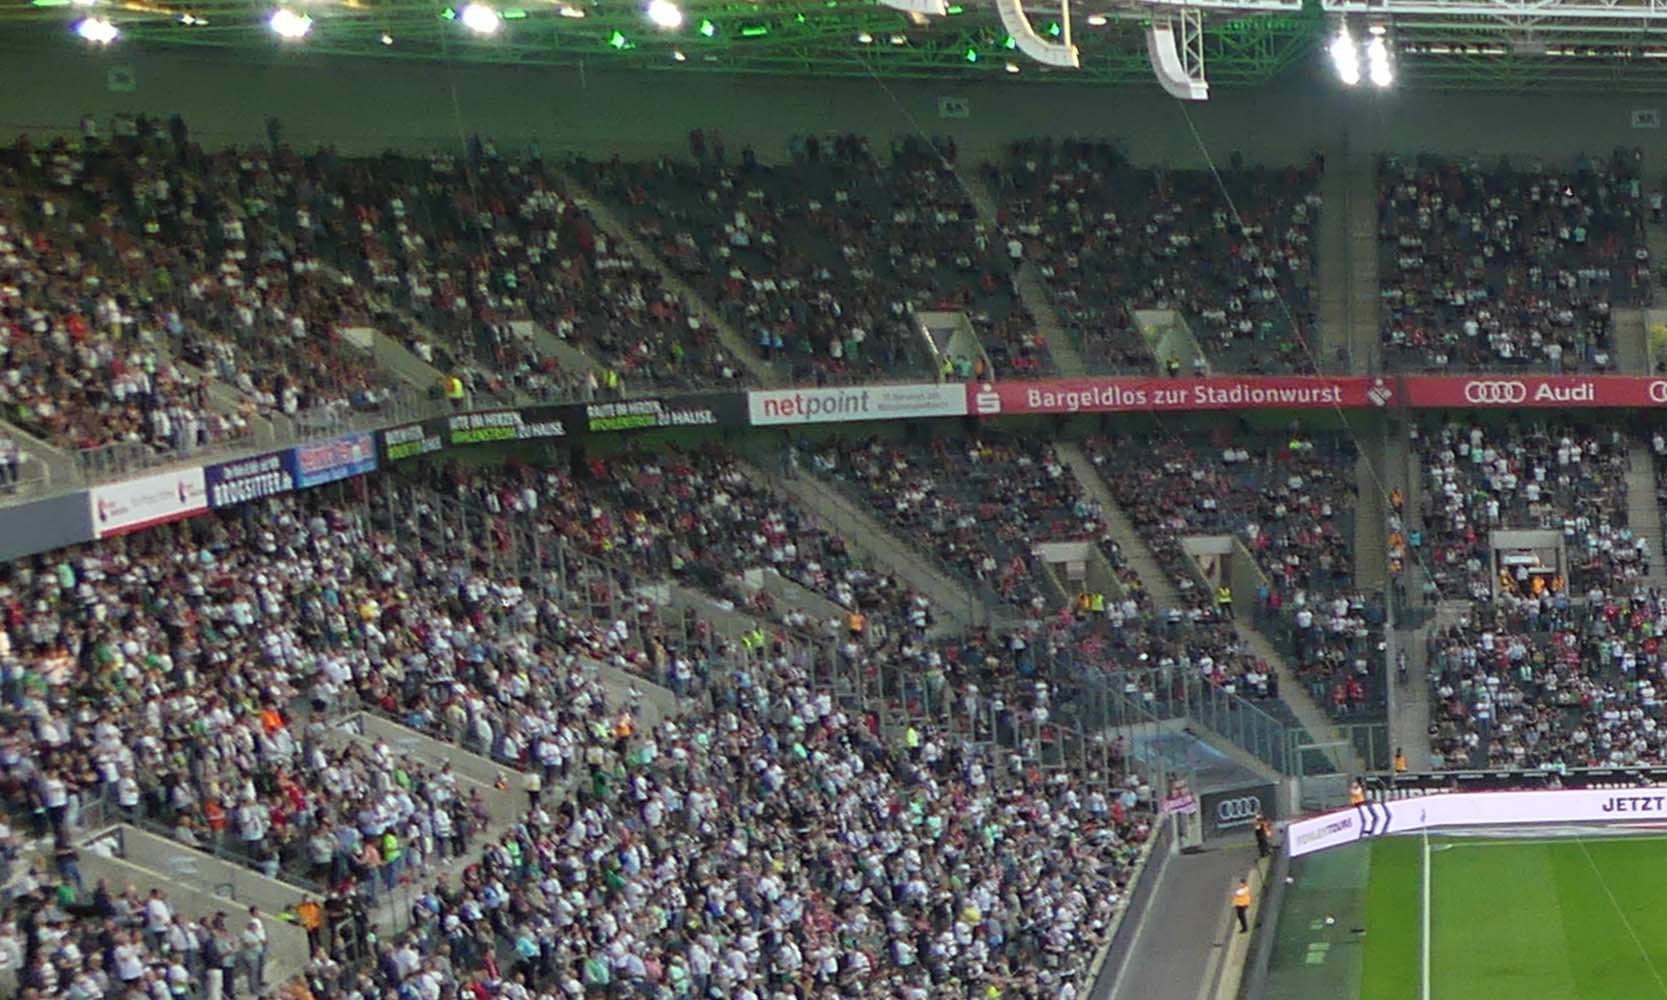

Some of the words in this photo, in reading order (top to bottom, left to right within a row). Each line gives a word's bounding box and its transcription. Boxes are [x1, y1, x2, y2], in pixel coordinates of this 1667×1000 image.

[1028, 386, 1146, 412] Bargeldlos
[1154, 390, 1188, 404] zur
[1195, 384, 1342, 404] Stadionwurst
[1535, 383, 1594, 401] Audi
[764, 390, 870, 419] netpoint
[1603, 794, 1663, 812] JETZT
